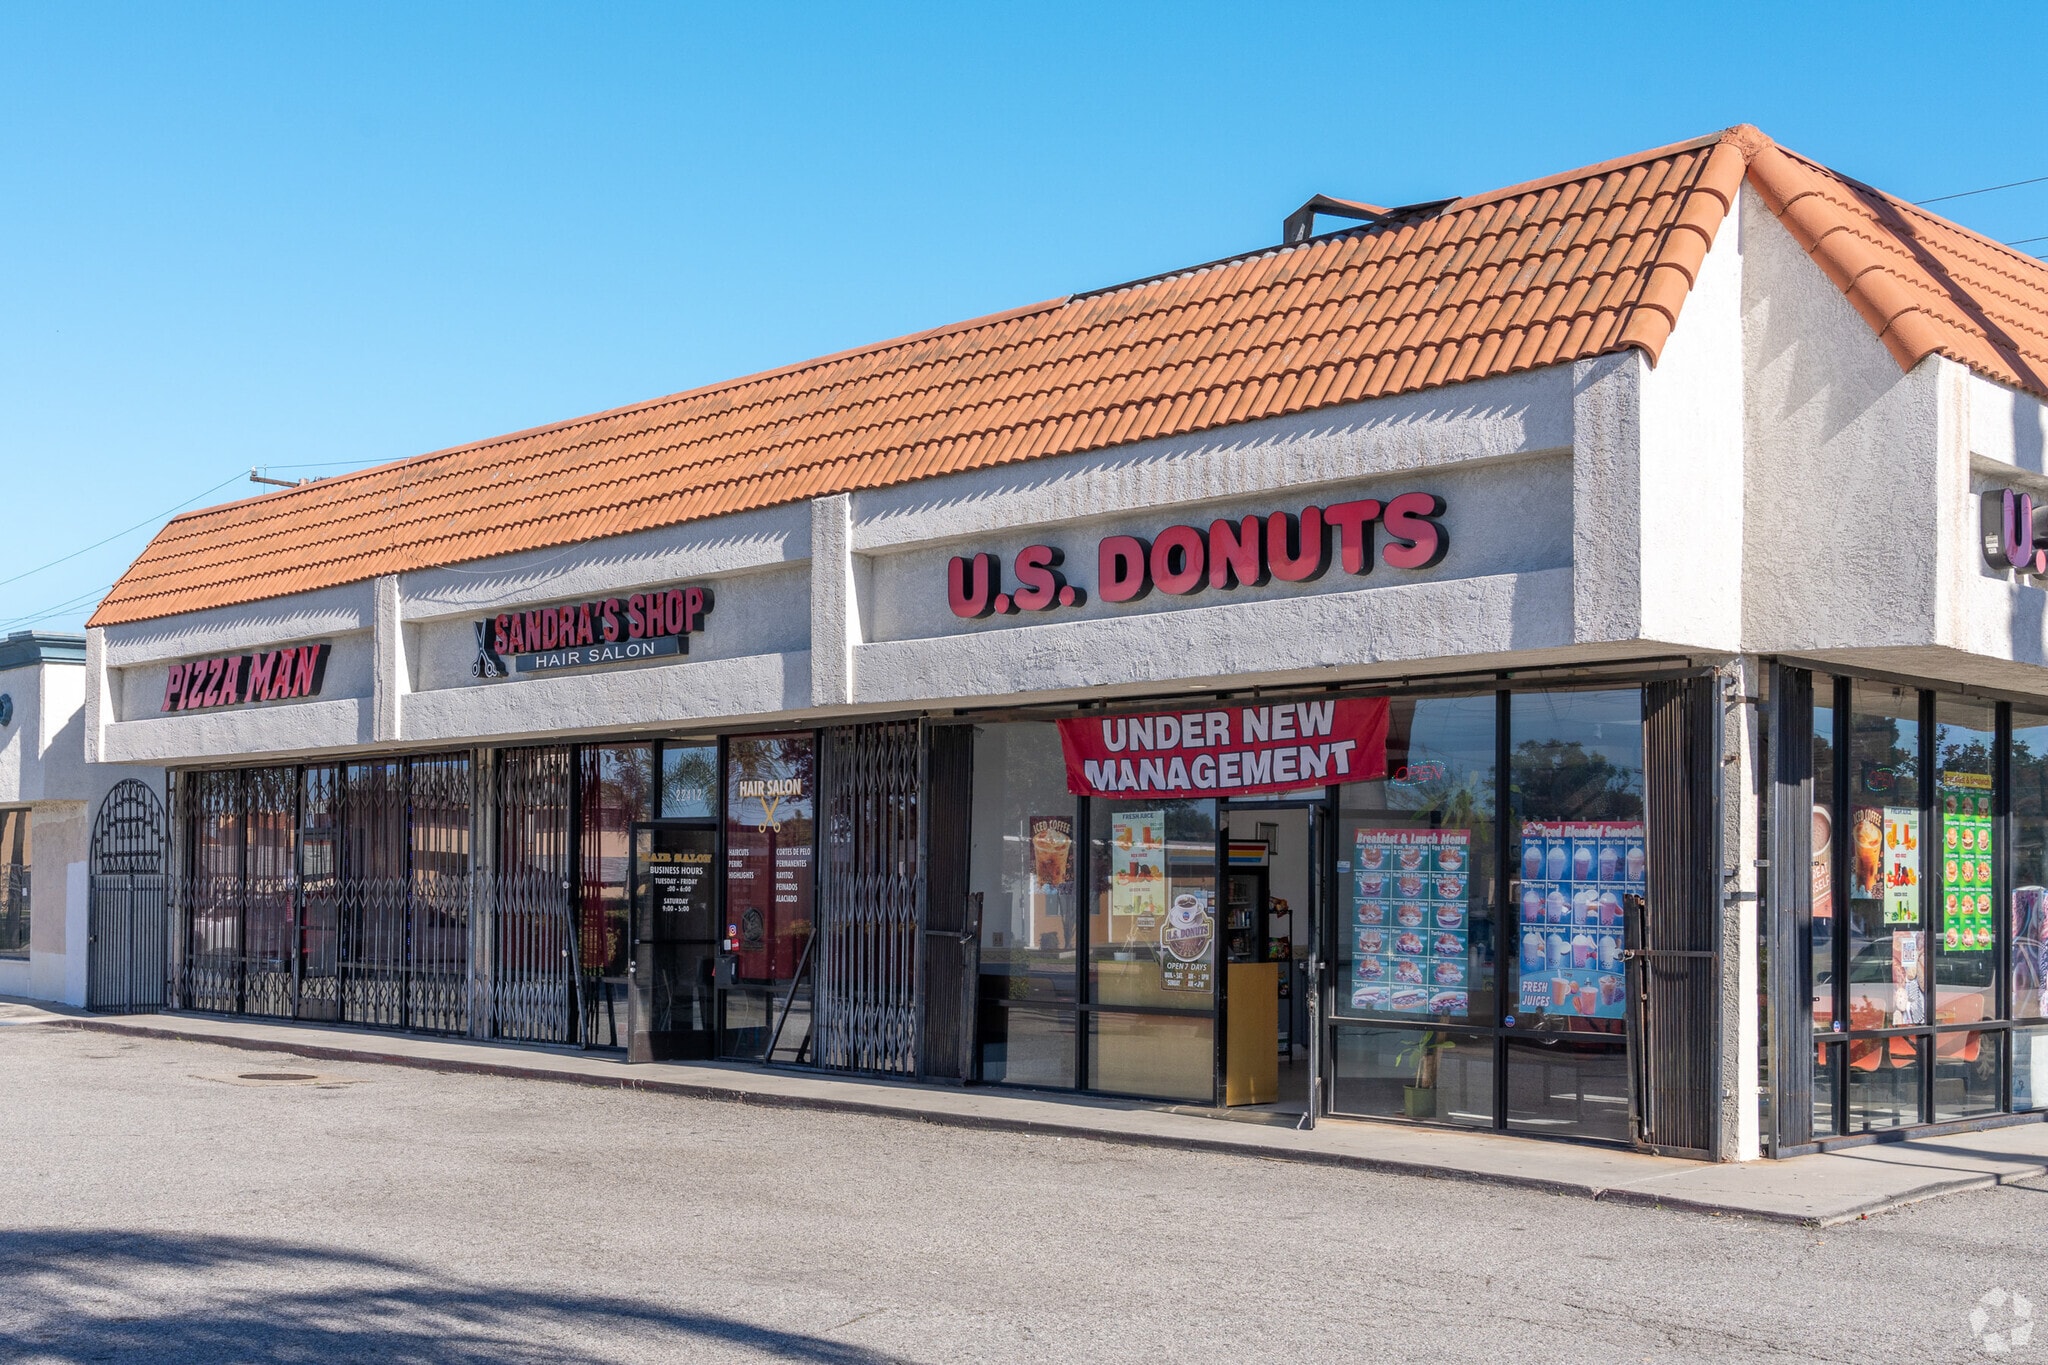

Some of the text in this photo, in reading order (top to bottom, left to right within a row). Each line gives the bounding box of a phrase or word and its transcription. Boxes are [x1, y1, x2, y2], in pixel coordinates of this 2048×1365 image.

[947, 491, 1439, 619] U.S. DONUTS
[494, 586, 704, 655] SANDRA'S SHOP
[536, 641, 655, 669] HAIR SALON
[160, 643, 321, 712] PIZZA MAN
[1101, 699, 1336, 753] UNDER NEW
[1083, 738, 1356, 792] MANAGEMENT
[1395, 765, 1443, 782] OPEN
[739, 778, 802, 797] HAIR SALON
[675, 788, 702, 802] 22412
[1853, 810, 1864, 825] ICED
[1864, 809, 1882, 827] COFFEE
[1032, 819, 1072, 834] ICED COFFEE
[1564, 824, 1604, 837] Blended
[1356, 832, 1467, 844] Breakfast & Lunch Menu
[728, 848, 749, 856] HAIRCUTS
[776, 847, 811, 856] CORTES DE PELO
[641, 853, 713, 863] HAIR SALON
[775, 859, 807, 868] PERMANENTES
[649, 866, 704, 875] BUSINESS HOURS
[728, 871, 754, 879] HIGHLIGHTS
[776, 871, 794, 879] RAYITOS
[776, 883, 798, 891] PEINADOS
[775, 894, 798, 903] ALACIADO
[1180, 925, 1209, 939] DONUTS
[1166, 962, 1184, 970] OPEN
[1190, 963, 1207, 971] DAYS
[1522, 981, 1548, 993] FRESH
[1522, 995, 1550, 1007] JUICES
